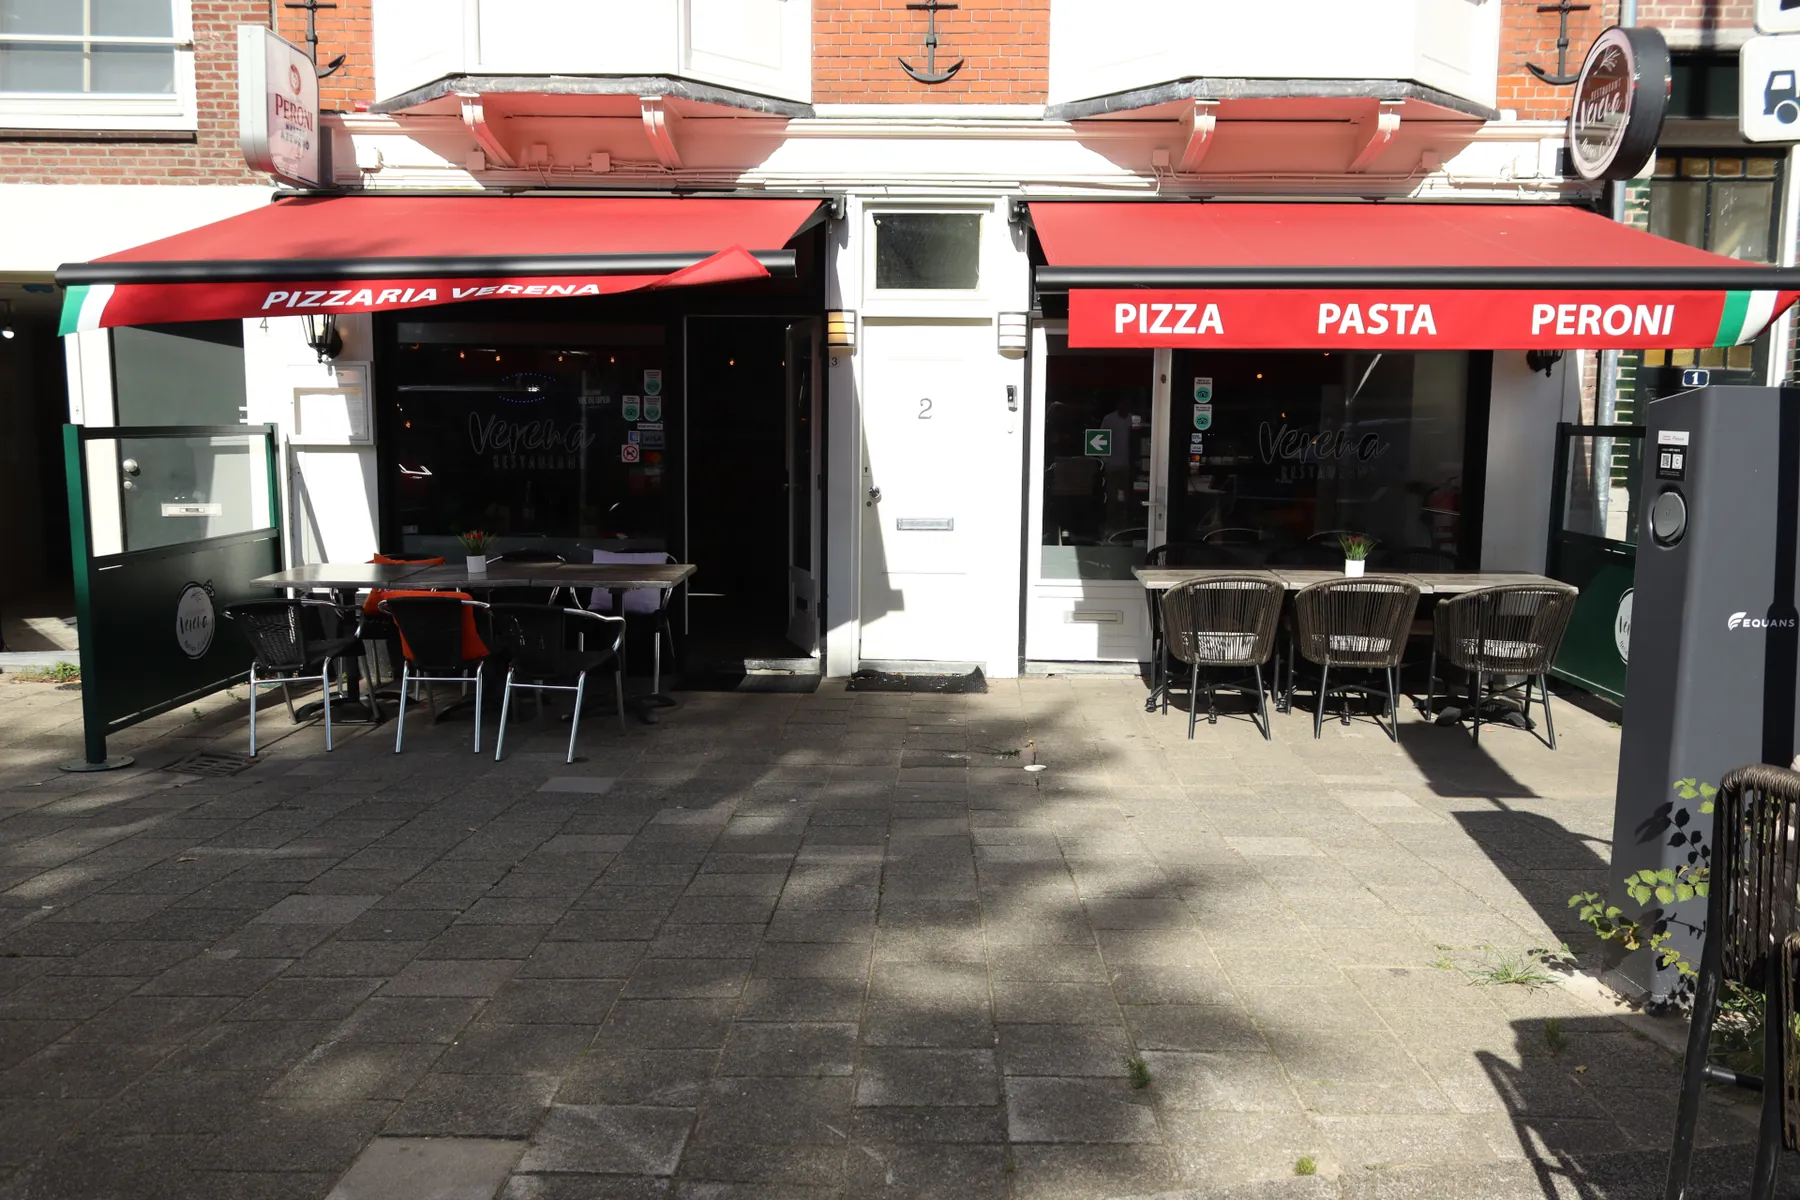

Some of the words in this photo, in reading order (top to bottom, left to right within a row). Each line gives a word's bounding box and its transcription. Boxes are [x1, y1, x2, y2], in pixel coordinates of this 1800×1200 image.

[275, 93, 313, 132] PERONI
[261, 288, 437, 310] PIZZARIA
[452, 284, 600, 298] VERENA
[1114, 303, 1224, 335] PIZZA
[1317, 303, 1437, 335] PASTA
[1531, 303, 1675, 336] PERONI
[831, 356, 838, 366] 3
[1692, 372, 1699, 385] 1
[918, 398, 932, 419] 2
[468, 411, 596, 455] Verena
[1259, 421, 1391, 465] Verena
[1743, 618, 1795, 628] EQUANS
